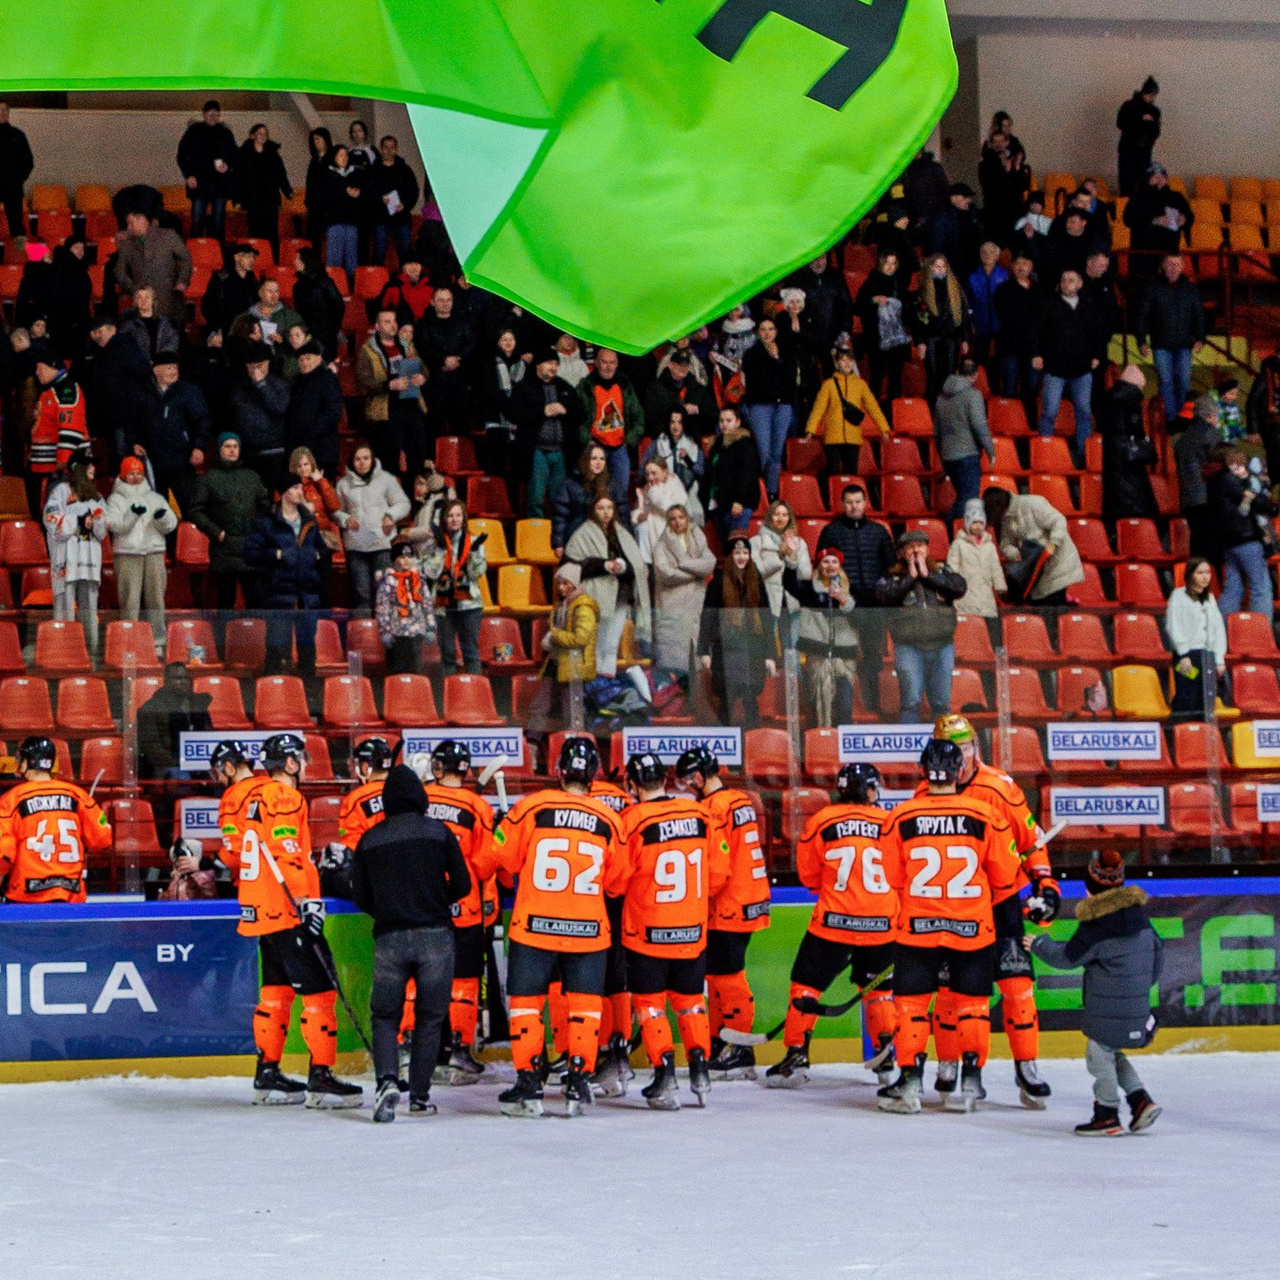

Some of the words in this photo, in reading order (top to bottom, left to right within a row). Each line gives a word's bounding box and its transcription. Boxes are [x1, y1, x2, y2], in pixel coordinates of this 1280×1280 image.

[1052, 734, 1157, 747] BELARUSKALI
[916, 816, 954, 835] ЯРУТА
[1055, 799, 1160, 812] BELARUSKALI
[26, 818, 80, 863] 45
[239, 829, 260, 881] 9
[532, 837, 604, 895] 62
[654, 847, 703, 903] 91
[824, 846, 891, 893] 76
[909, 845, 982, 899] 22
[157, 943, 194, 962] BY
